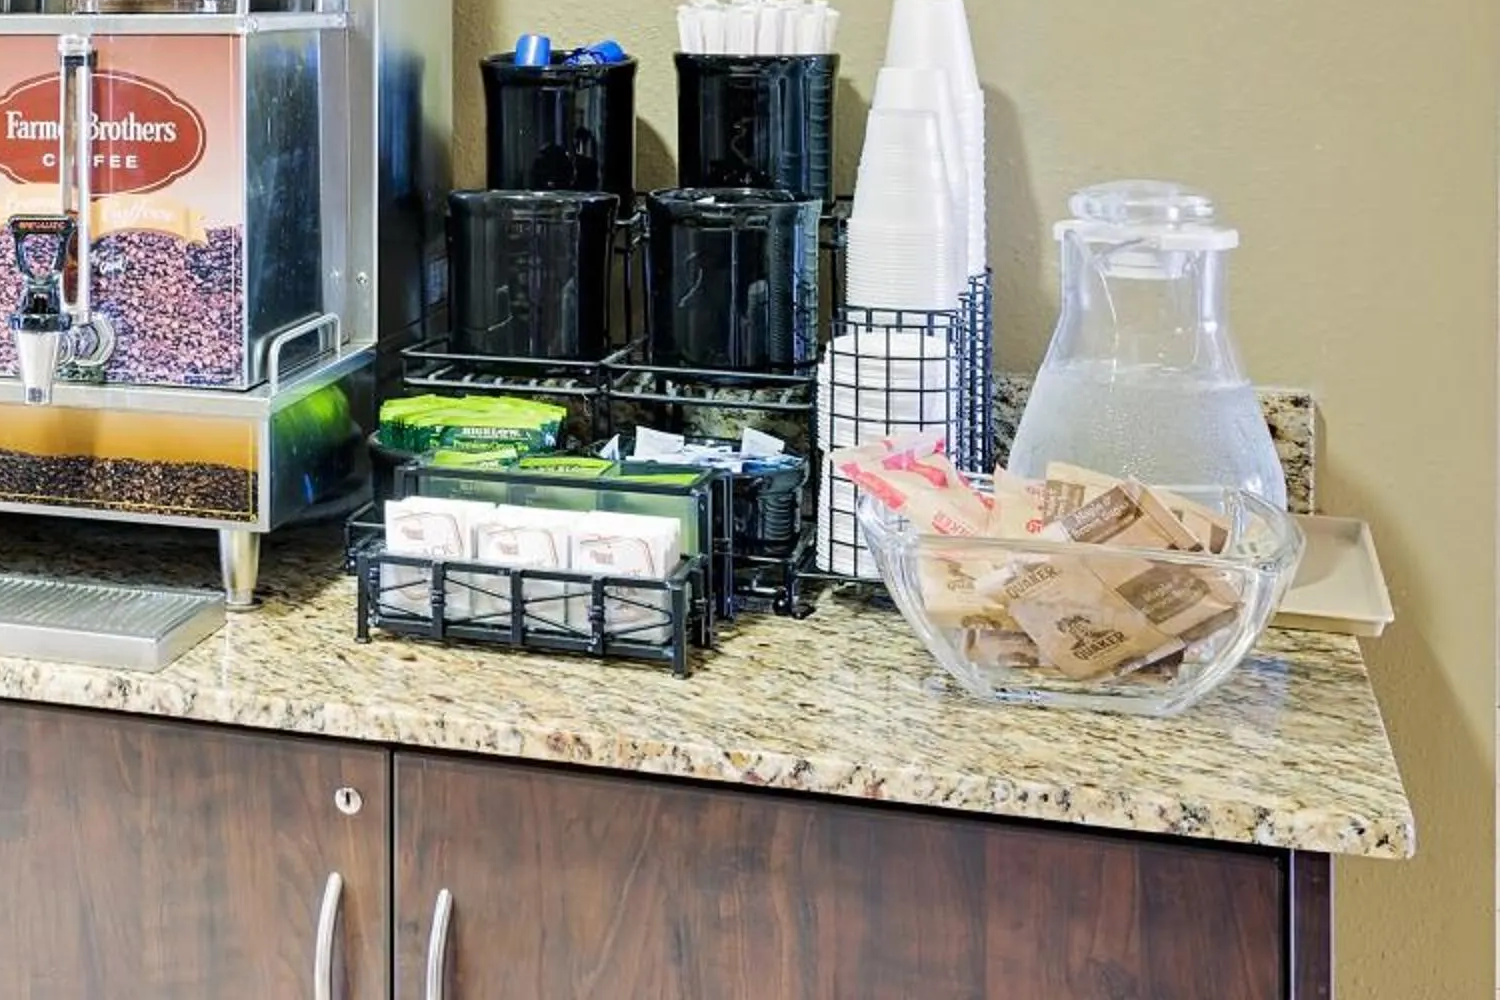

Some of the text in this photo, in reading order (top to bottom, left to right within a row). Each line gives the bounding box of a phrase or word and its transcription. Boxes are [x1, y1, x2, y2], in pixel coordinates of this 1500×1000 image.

[5, 110, 61, 141] Farm
[42, 153, 140, 169] CFEE
[1005, 565, 1059, 599] QUAKER
[1073, 630, 1126, 661] QUAKER
